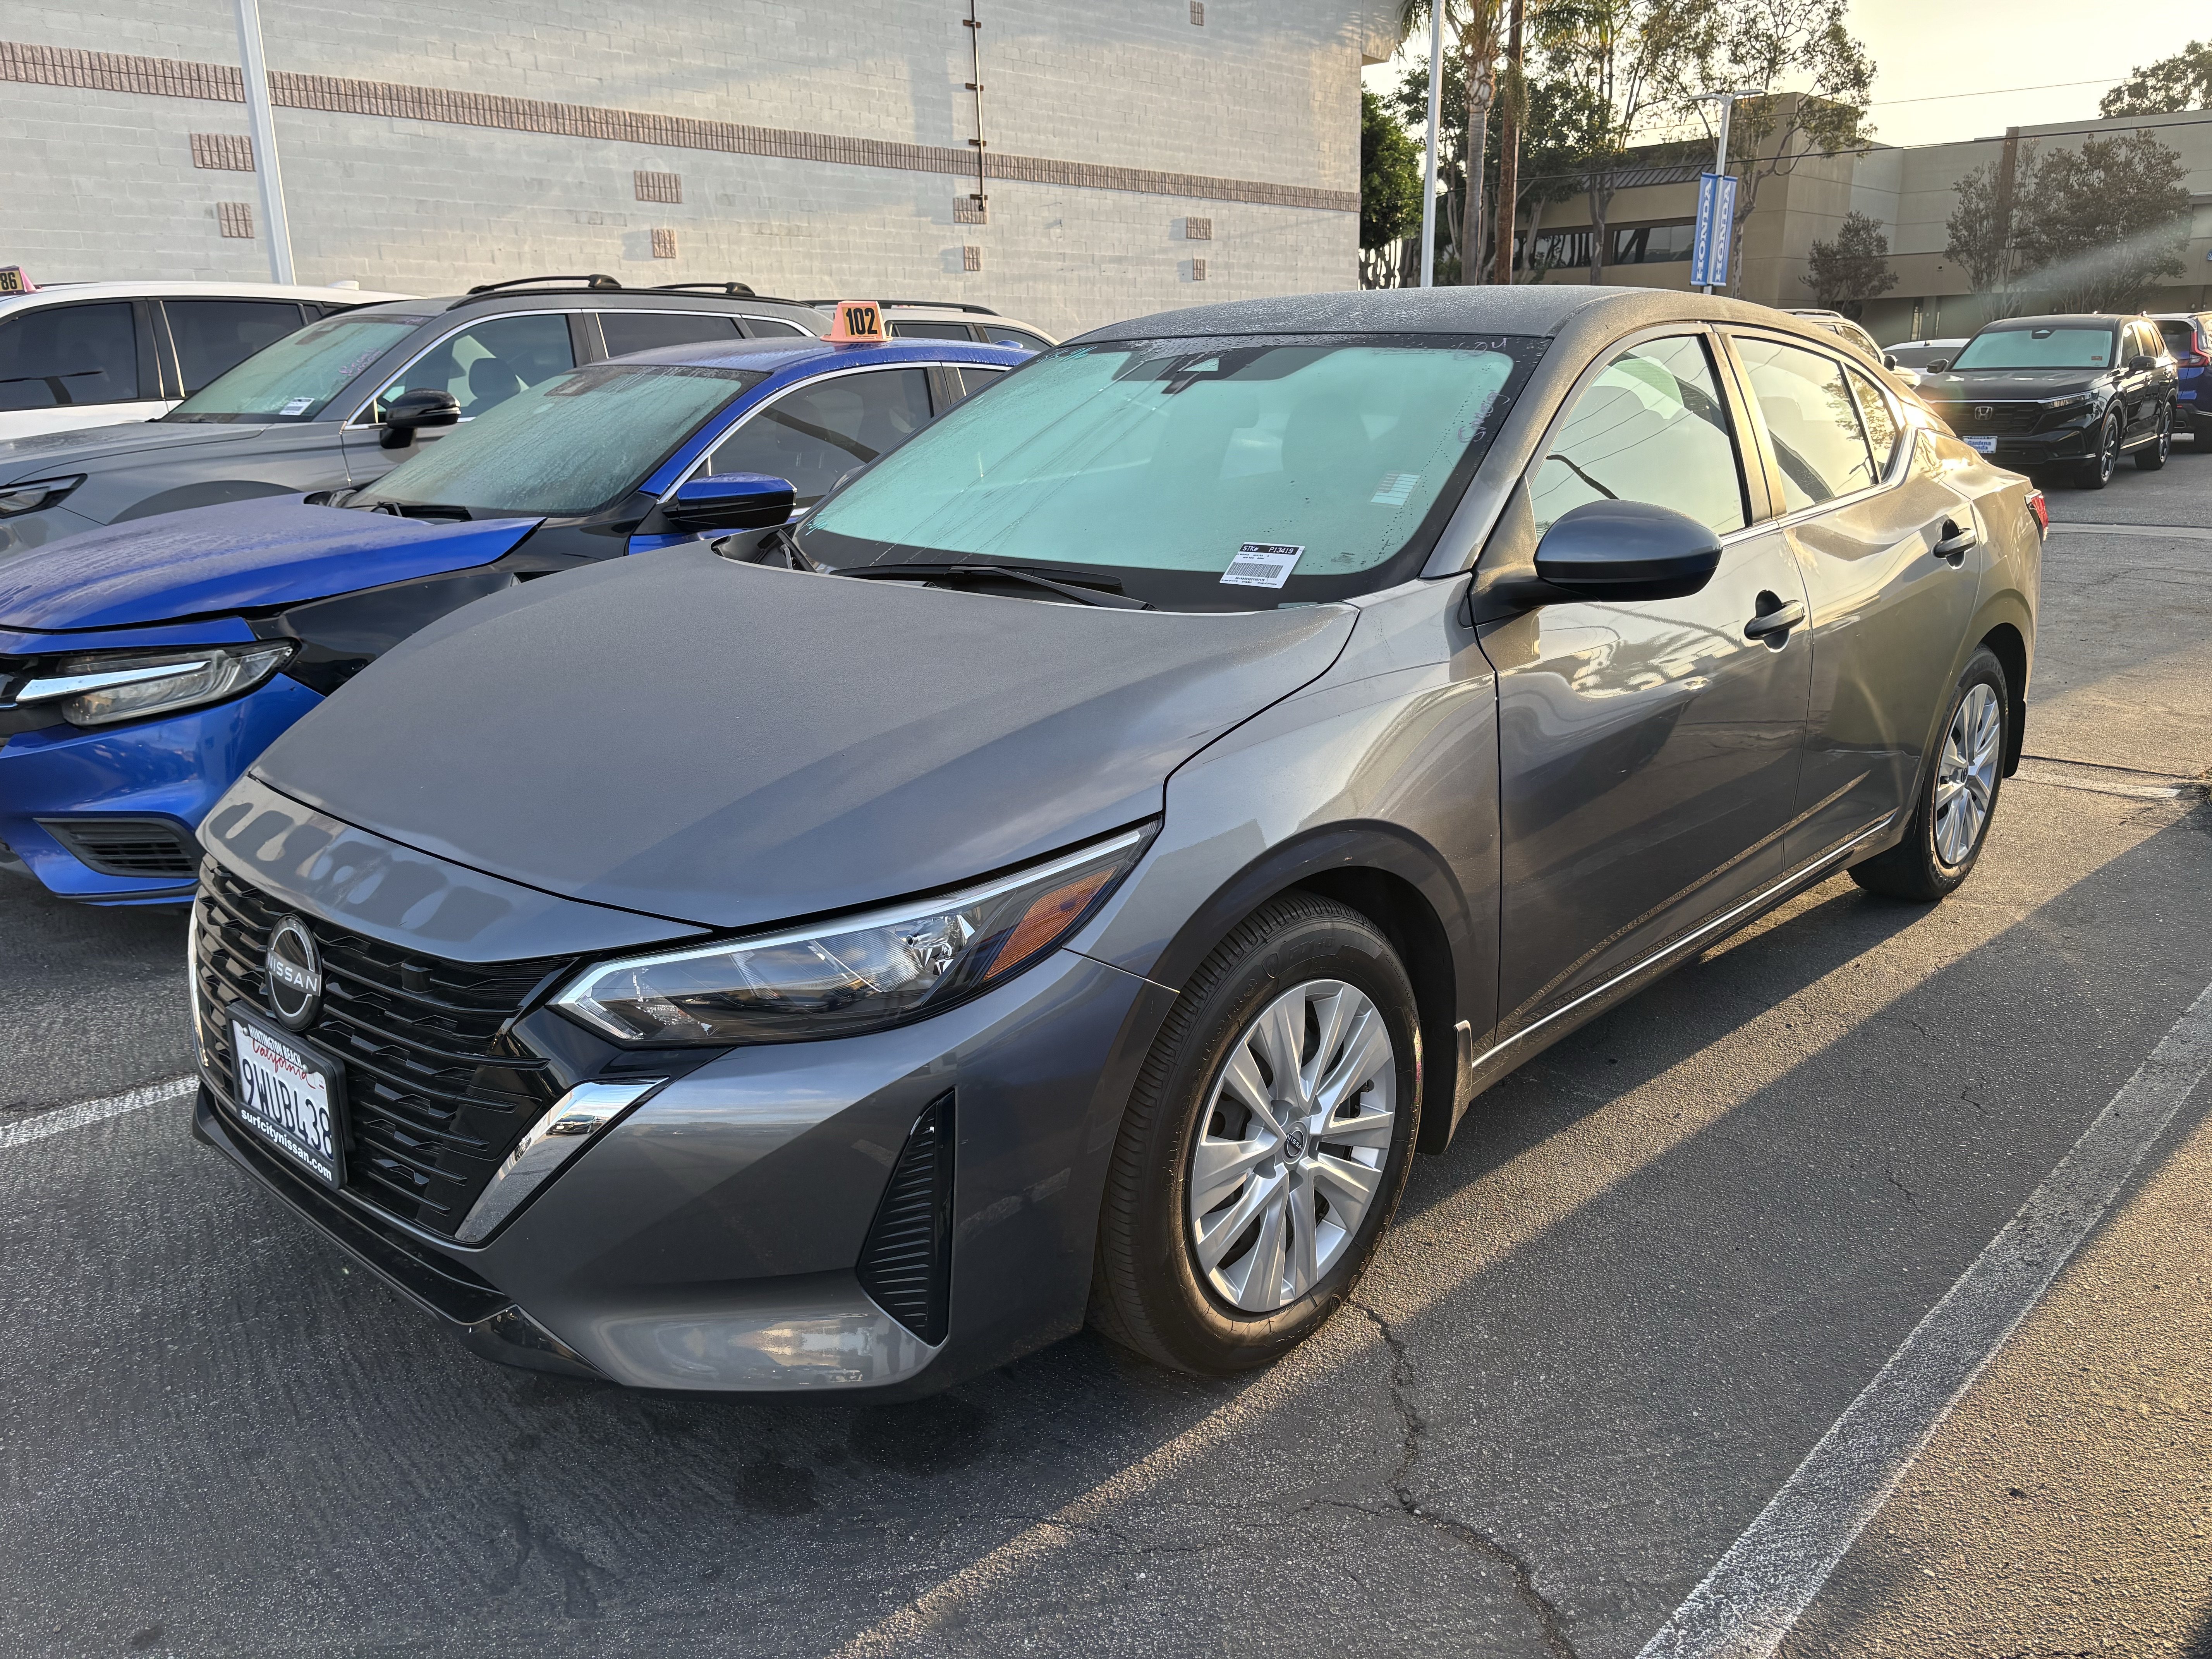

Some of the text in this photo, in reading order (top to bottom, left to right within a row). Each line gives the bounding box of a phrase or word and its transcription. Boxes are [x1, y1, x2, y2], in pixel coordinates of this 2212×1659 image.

[1696, 179, 1712, 282] HONDA
[1715, 182, 1731, 282] HONDA
[0, 272, 17, 290] 86
[846, 308, 878, 335] 102
[266, 954, 318, 994] NISSAN
[248, 1024, 303, 1069] HUNTINGTON BEACH
[252, 1039, 316, 1089] California
[242, 1058, 334, 1160] 9WUB438
[241, 1109, 332, 1181] surfcitynissan.com
[1286, 1134, 1304, 1152] NISSAN
